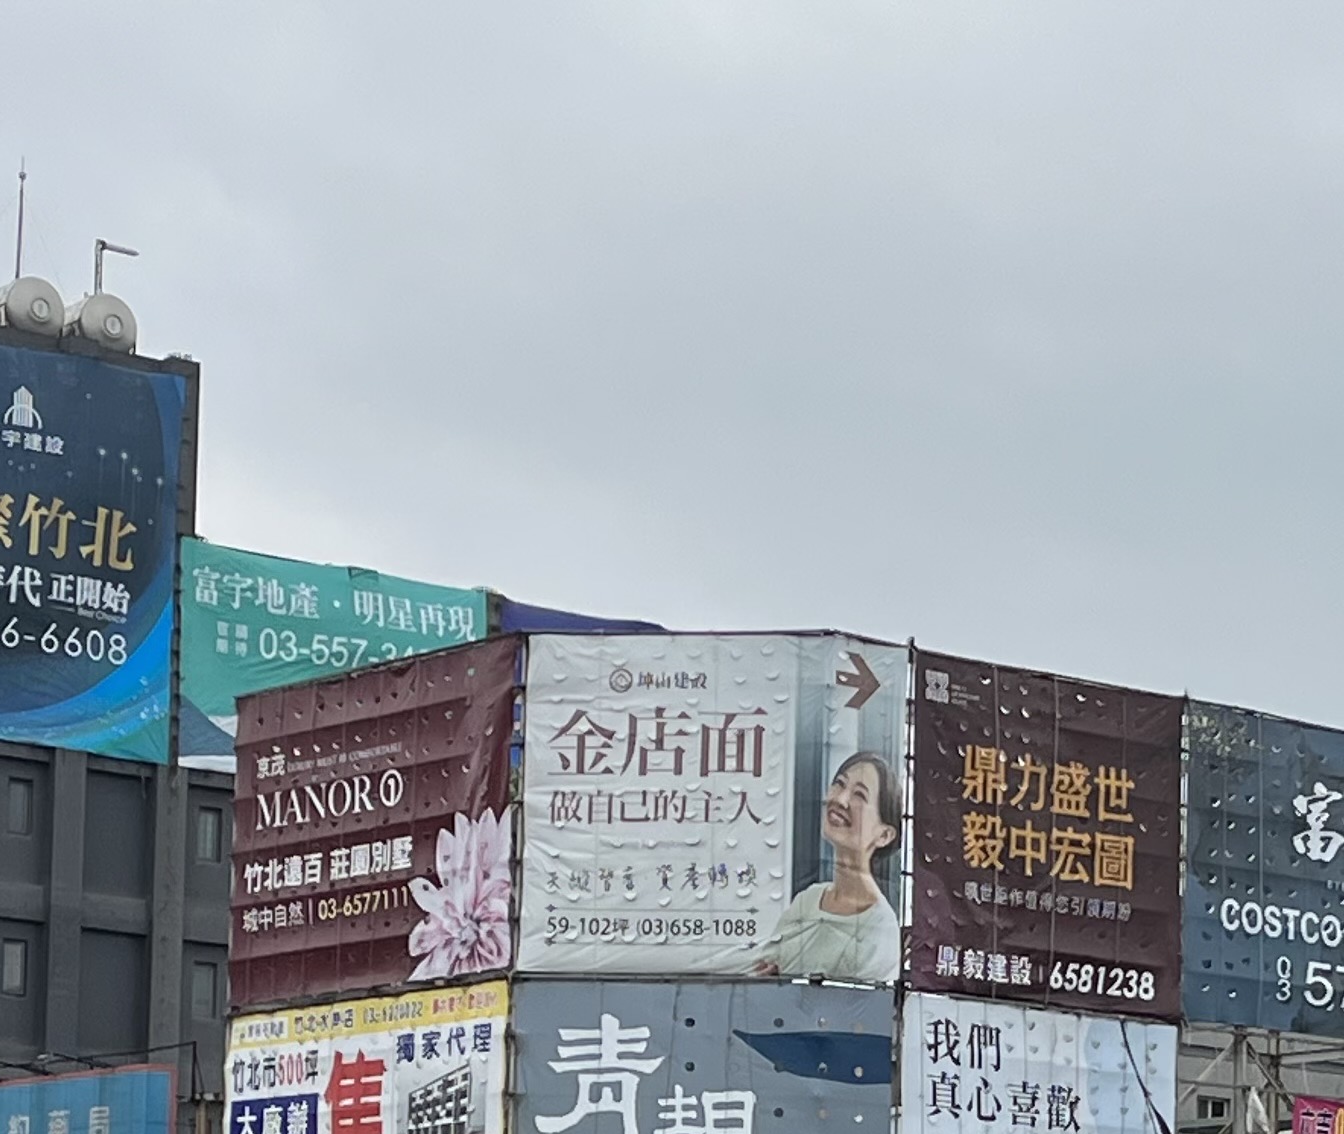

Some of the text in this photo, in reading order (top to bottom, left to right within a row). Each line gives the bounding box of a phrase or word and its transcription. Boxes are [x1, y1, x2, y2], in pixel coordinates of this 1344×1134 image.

[47, 573, 131, 615] 正開始
[547, 707, 768, 778] 金店面
[257, 775, 375, 830] MANOR
[547, 789, 763, 826] 做自己的主人
[962, 744, 1135, 824] 鼎力盛世
[243, 836, 413, 894] 竹北遠百 莊園別墅
[962, 811, 1135, 890] 毅中宏圖
[317, 885, 409, 922] 03-6577111
[546, 916, 757, 938] 59-102坪 (03)658-1088
[1220, 899, 1343, 948] COSTCO
[1049, 961, 1155, 1000] 6581238
[395, 1022, 493, 1066] 獨家代理
[926, 1018, 1001, 1072] 我們
[232, 1049, 319, 1094] 竹北市500坪
[926, 1071, 1081, 1132] 真心喜歡
